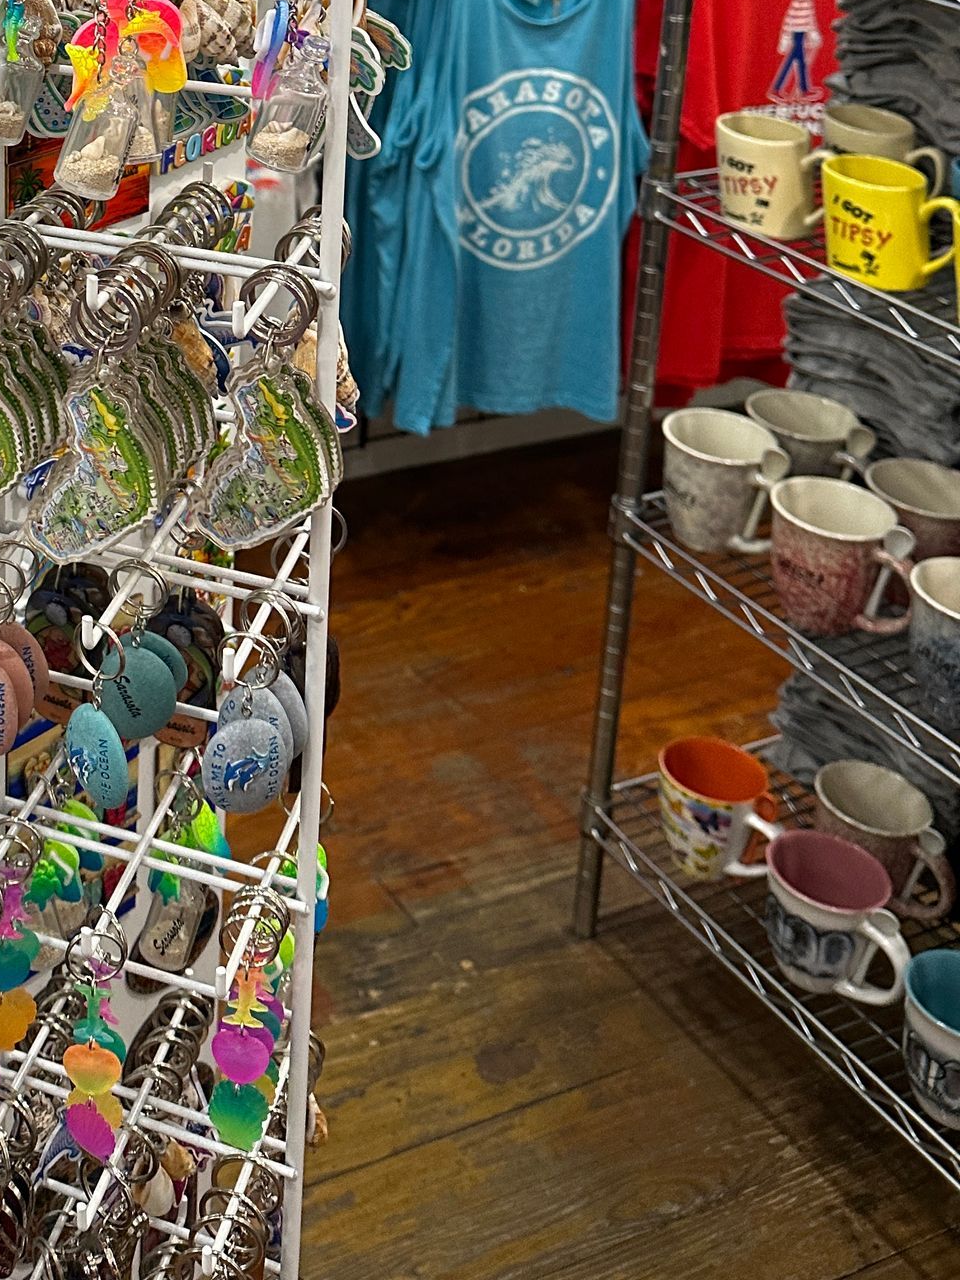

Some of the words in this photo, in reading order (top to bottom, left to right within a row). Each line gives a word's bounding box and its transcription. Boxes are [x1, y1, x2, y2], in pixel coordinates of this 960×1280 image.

[161, 116, 251, 174] FLORIDA
[727, 156, 754, 175] GOT
[723, 175, 778, 197] TIPSY
[841, 200, 874, 224] GOT
[832, 216, 893, 250] TIPSY
[114, 675, 142, 719] Sarasota
[224, 699, 236, 711] TO
[98, 739, 111, 780] OCEAN
[213, 743, 226, 759] TO
[268, 735, 280, 775] OCEAN
[212, 763, 223, 782] ME
[98, 781, 112, 802] THE
[265, 776, 279, 800] THE
